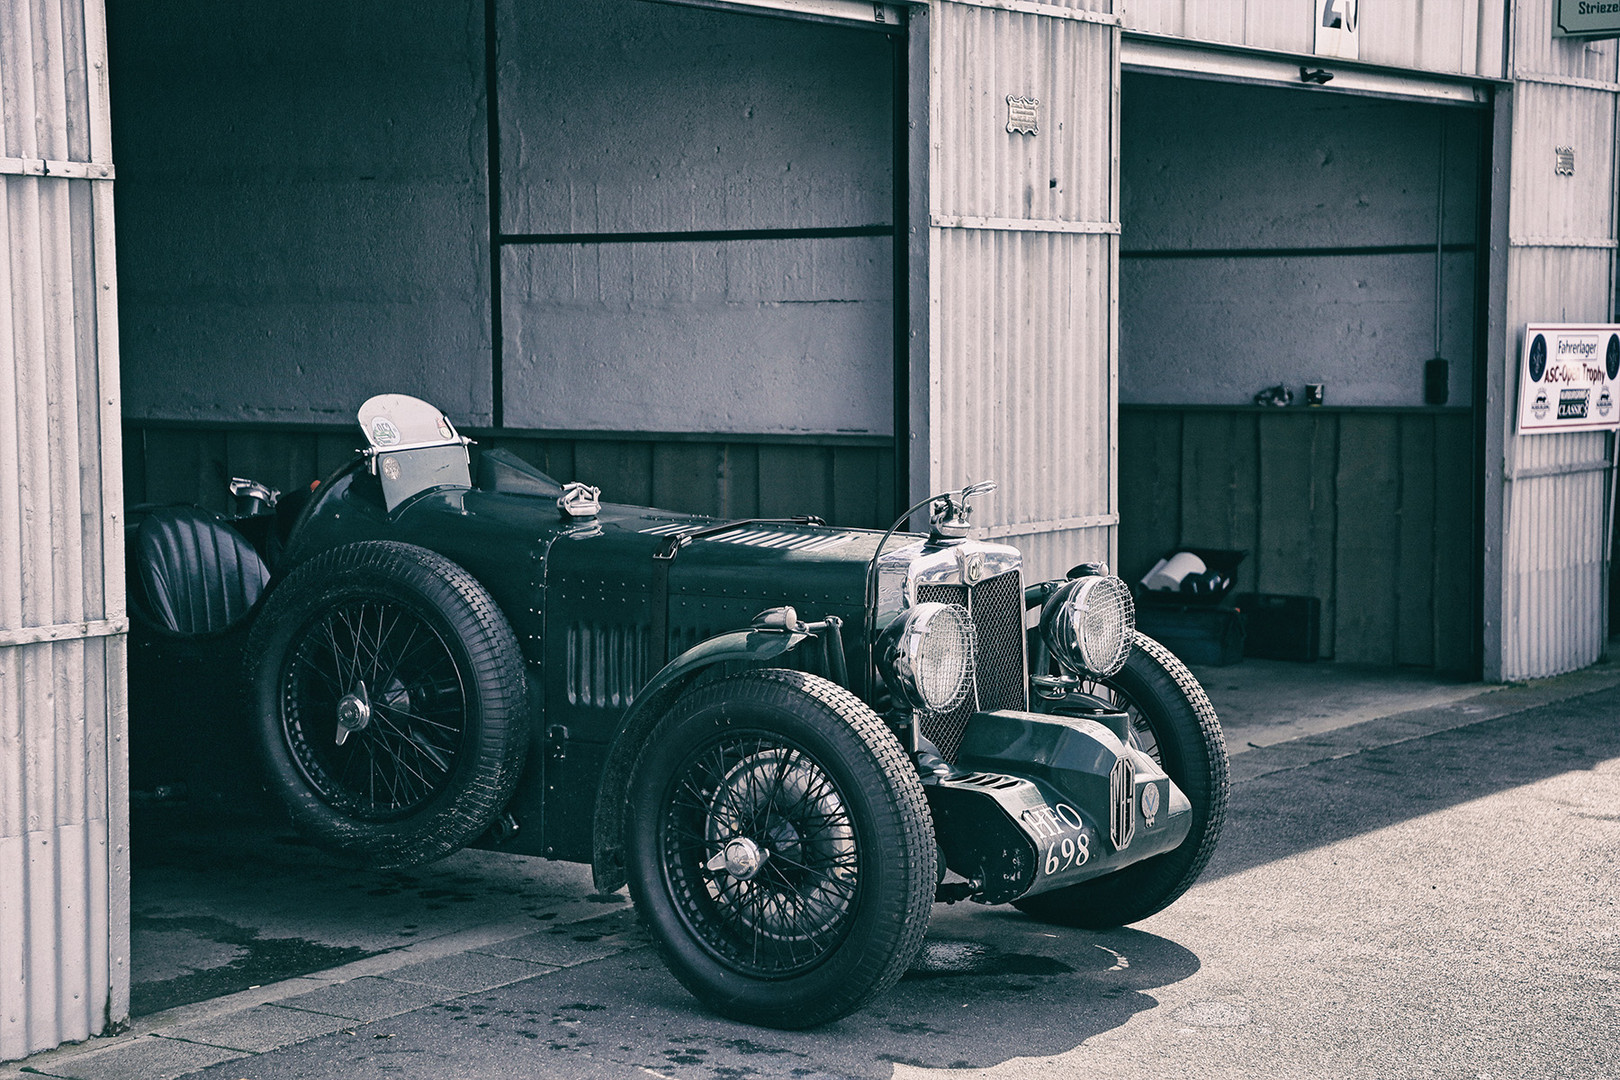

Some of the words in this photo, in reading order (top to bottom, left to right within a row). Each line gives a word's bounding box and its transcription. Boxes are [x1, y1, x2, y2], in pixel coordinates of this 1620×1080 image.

[1579, 0, 1620, 15] Strieze
[1558, 340, 1597, 357] Fahrerlager
[1582, 363, 1606, 386] Trophy
[1020, 802, 1083, 839] HFO
[1044, 834, 1090, 876] 698
